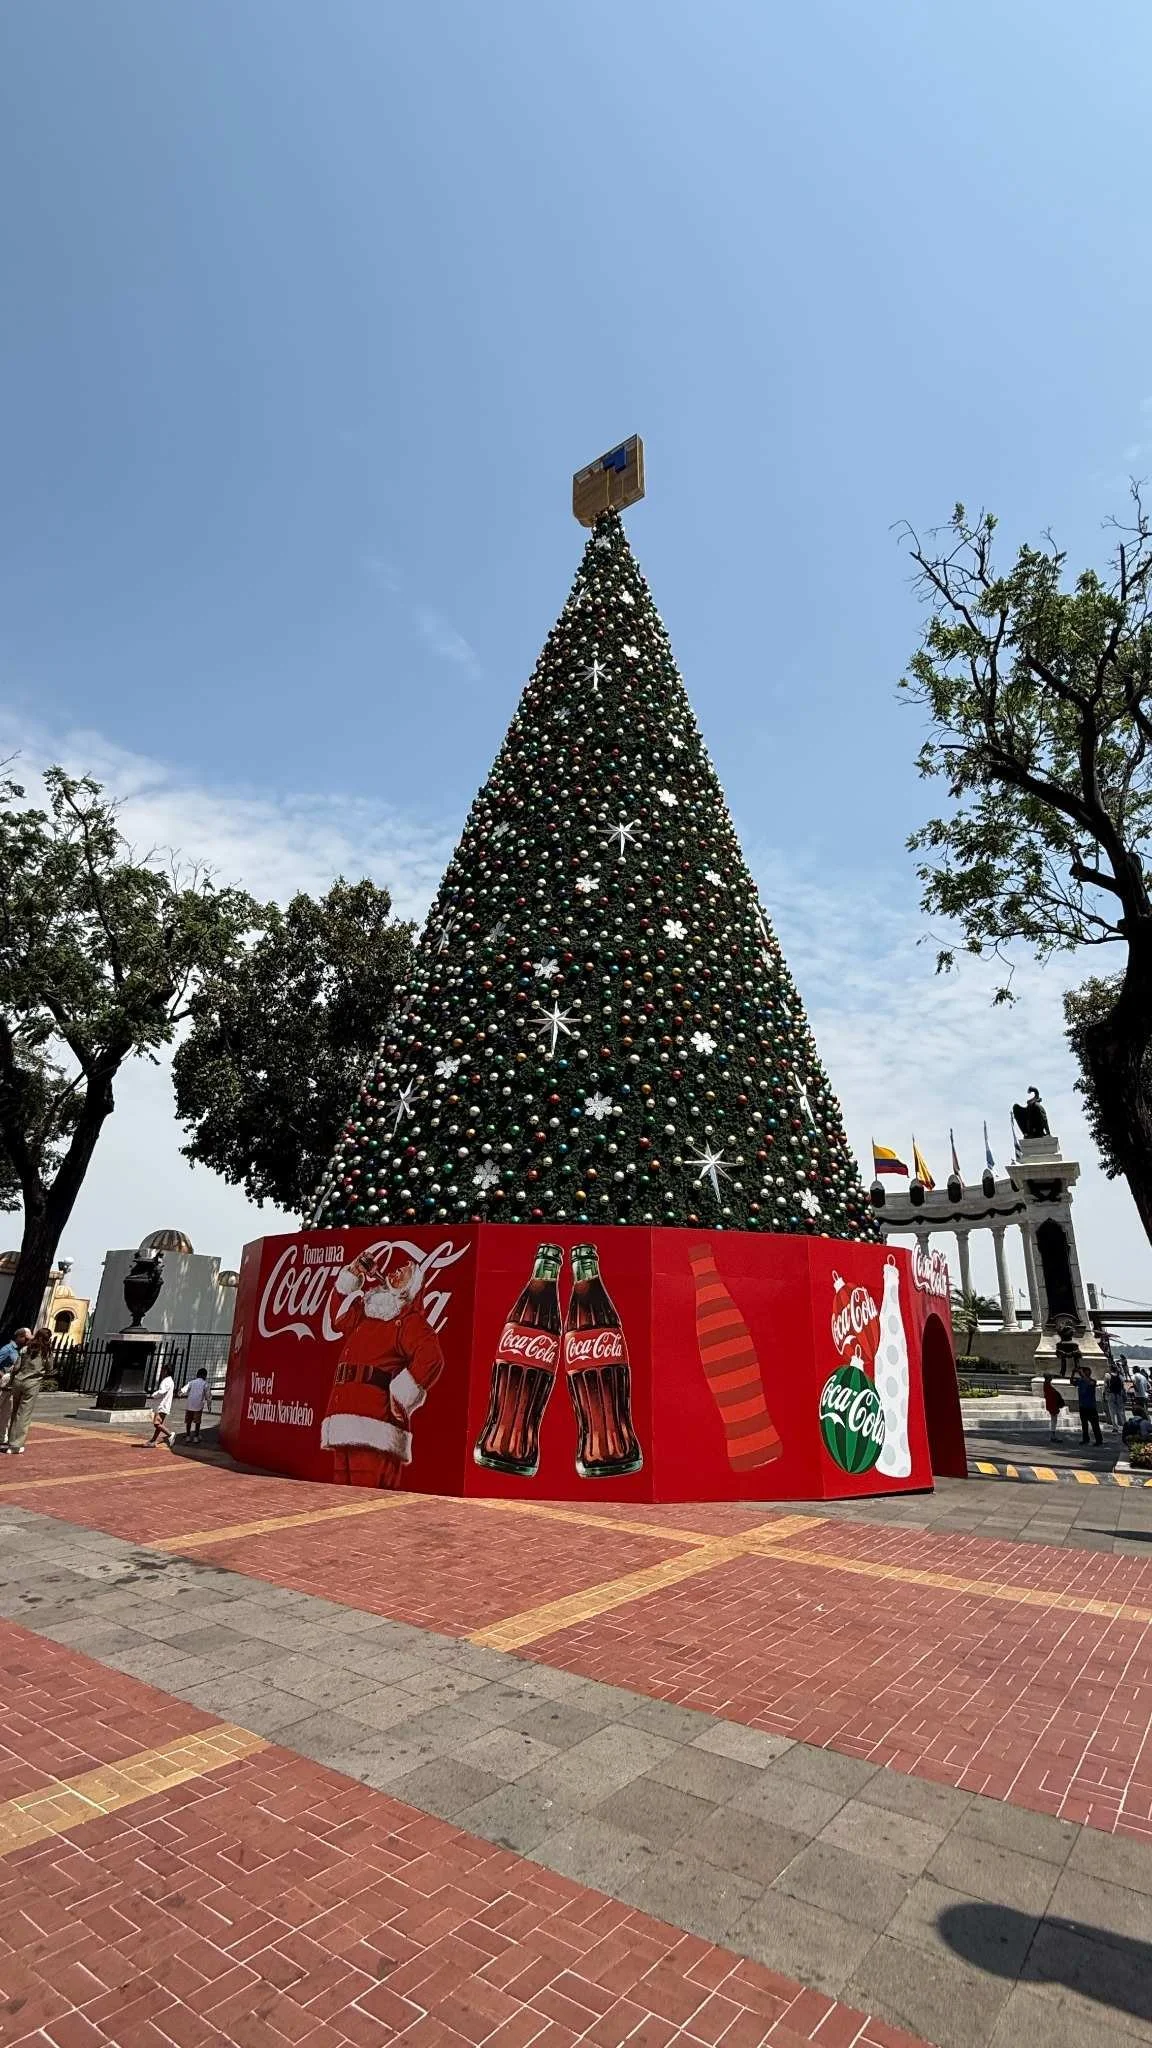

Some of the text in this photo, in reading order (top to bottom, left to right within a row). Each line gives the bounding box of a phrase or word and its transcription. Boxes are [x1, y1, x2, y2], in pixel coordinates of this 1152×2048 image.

[303, 1244, 344, 1265] Toma una
[832, 1287, 878, 1355] Coca-Cola
[499, 1328, 558, 1363] Coca-Cola
[564, 1332, 622, 1364] Coca-Cola
[251, 1371, 275, 1395] Vive el
[247, 1397, 314, 1427] Espíritu Navideño
[819, 1374, 886, 1446] Coca-Cola
